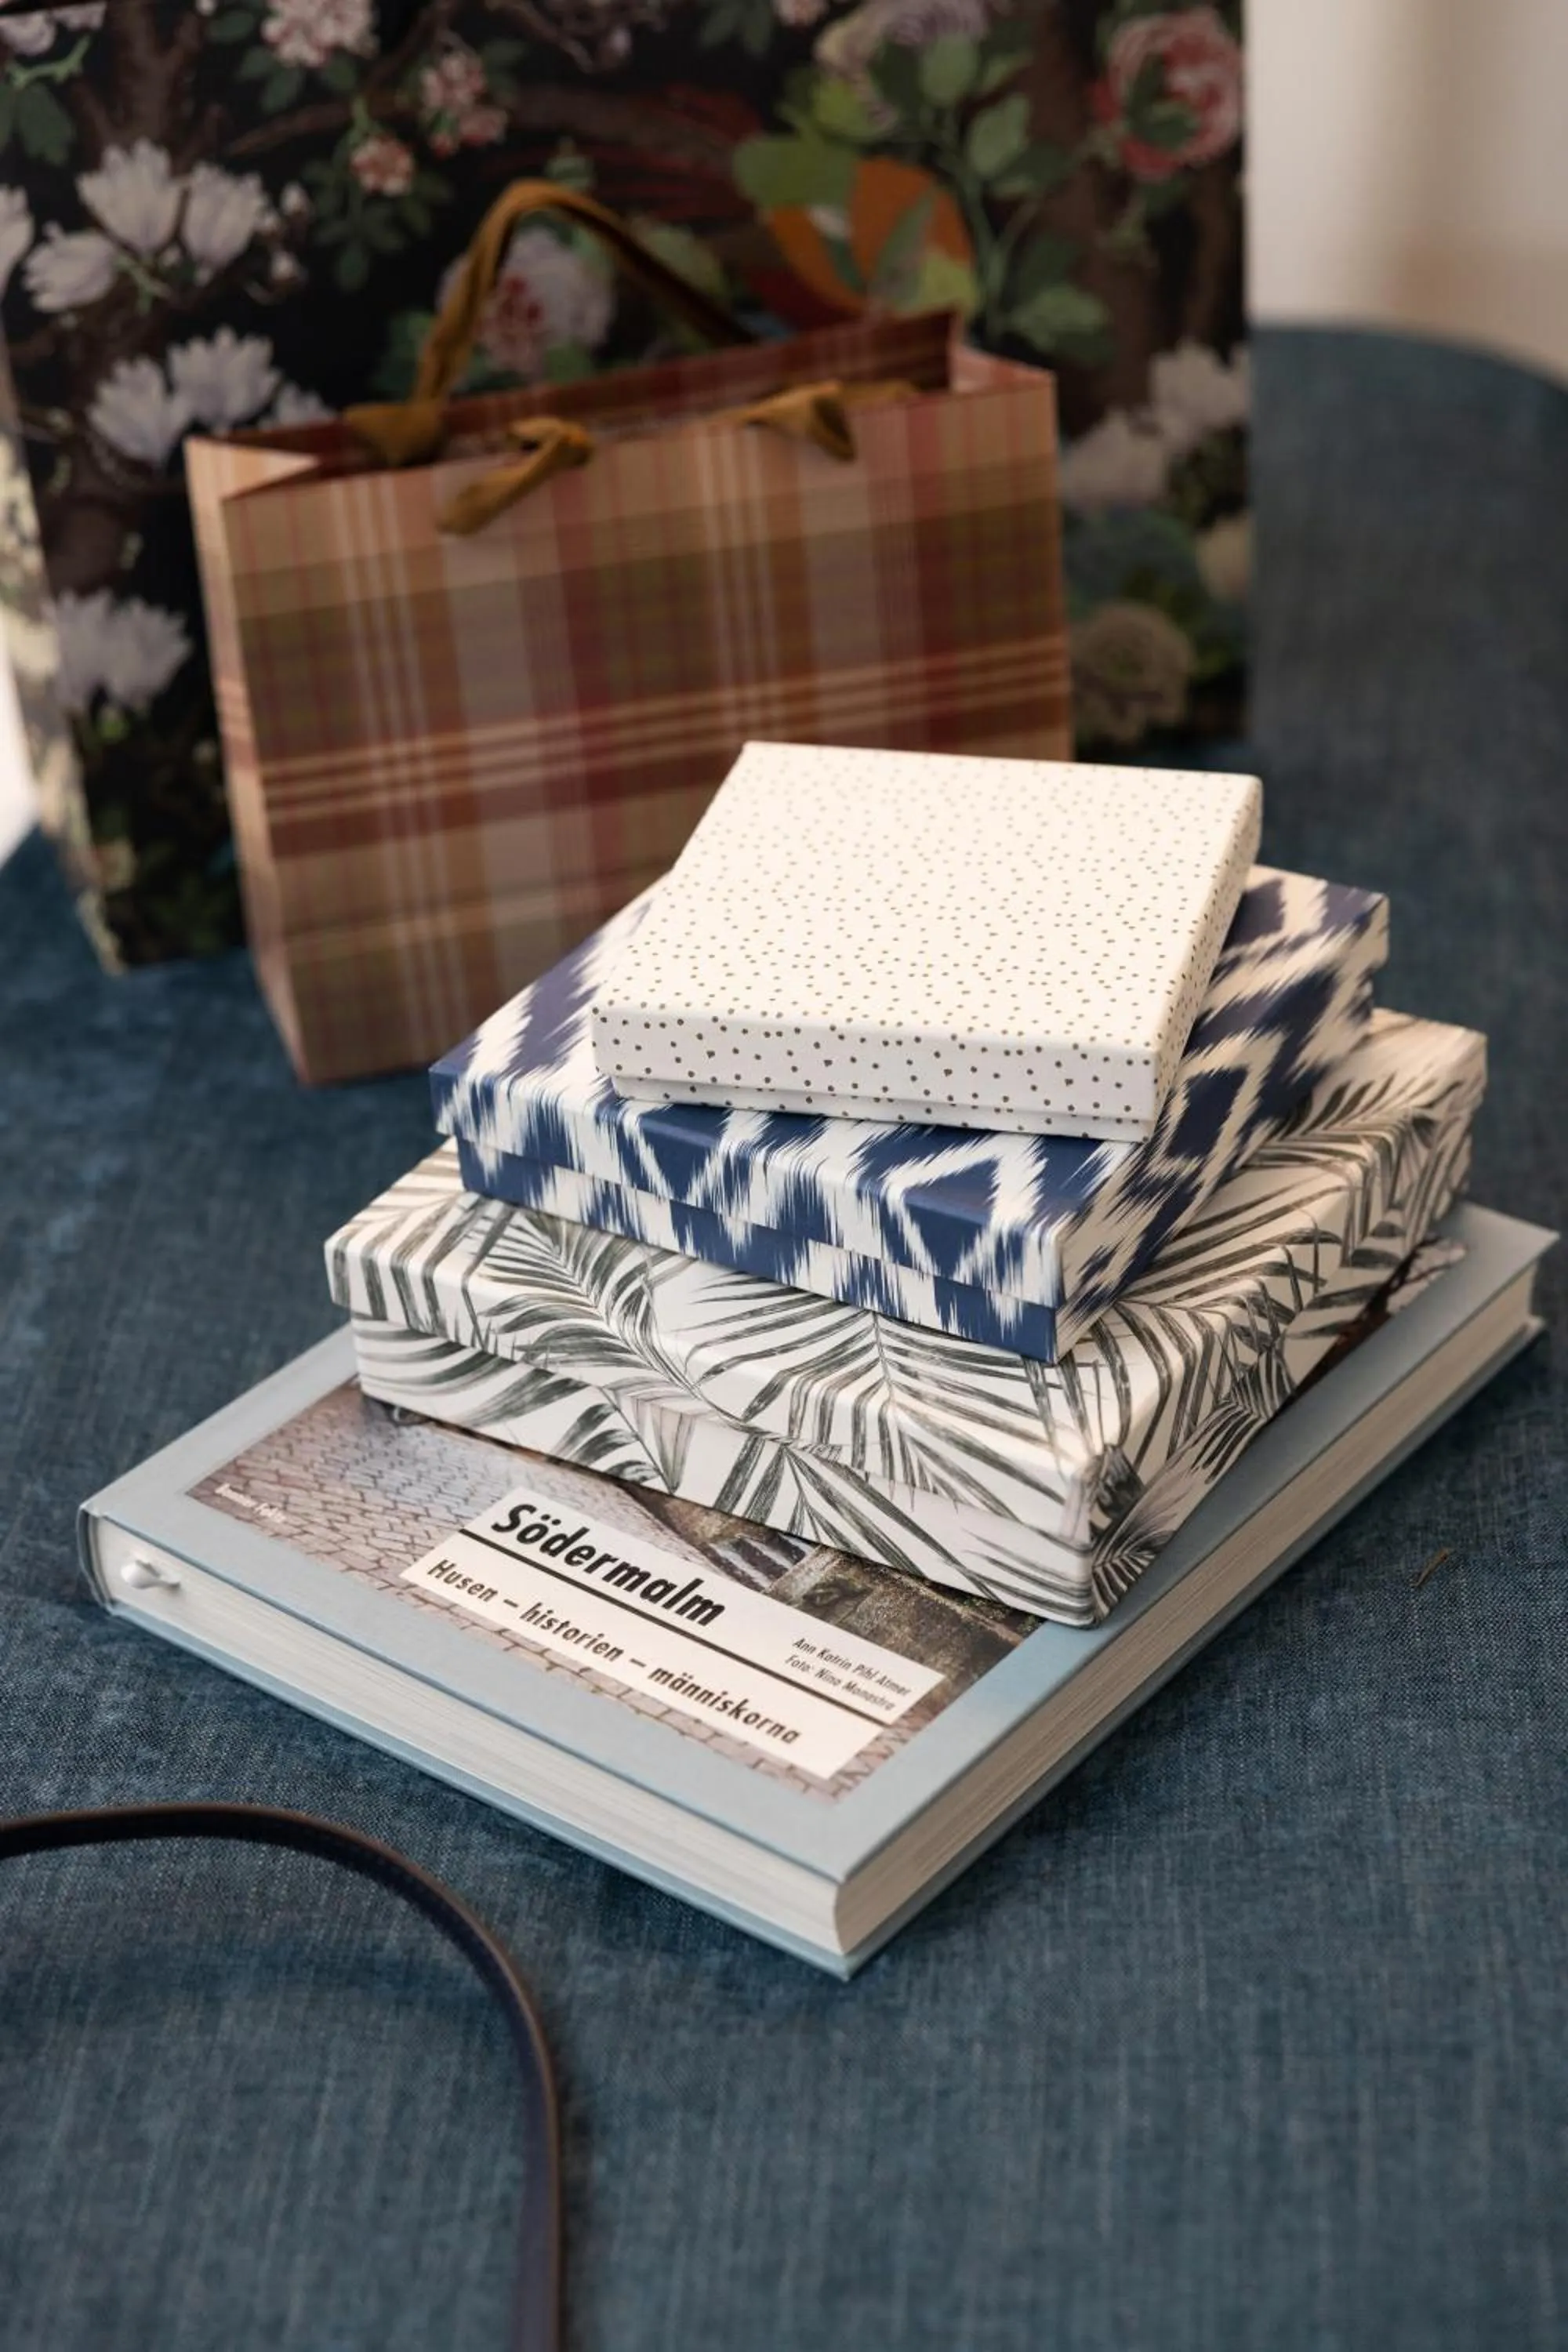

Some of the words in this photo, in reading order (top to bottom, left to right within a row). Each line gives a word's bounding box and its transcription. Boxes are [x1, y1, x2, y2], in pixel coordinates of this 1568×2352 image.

[491, 1504, 725, 1626] Södermalm
[427, 1559, 499, 1602] Husen
[520, 1602, 624, 1661] historien
[648, 1668, 800, 1744] människorna
[793, 1638, 817, 1654] Ann
[818, 1647, 852, 1671] Katrin
